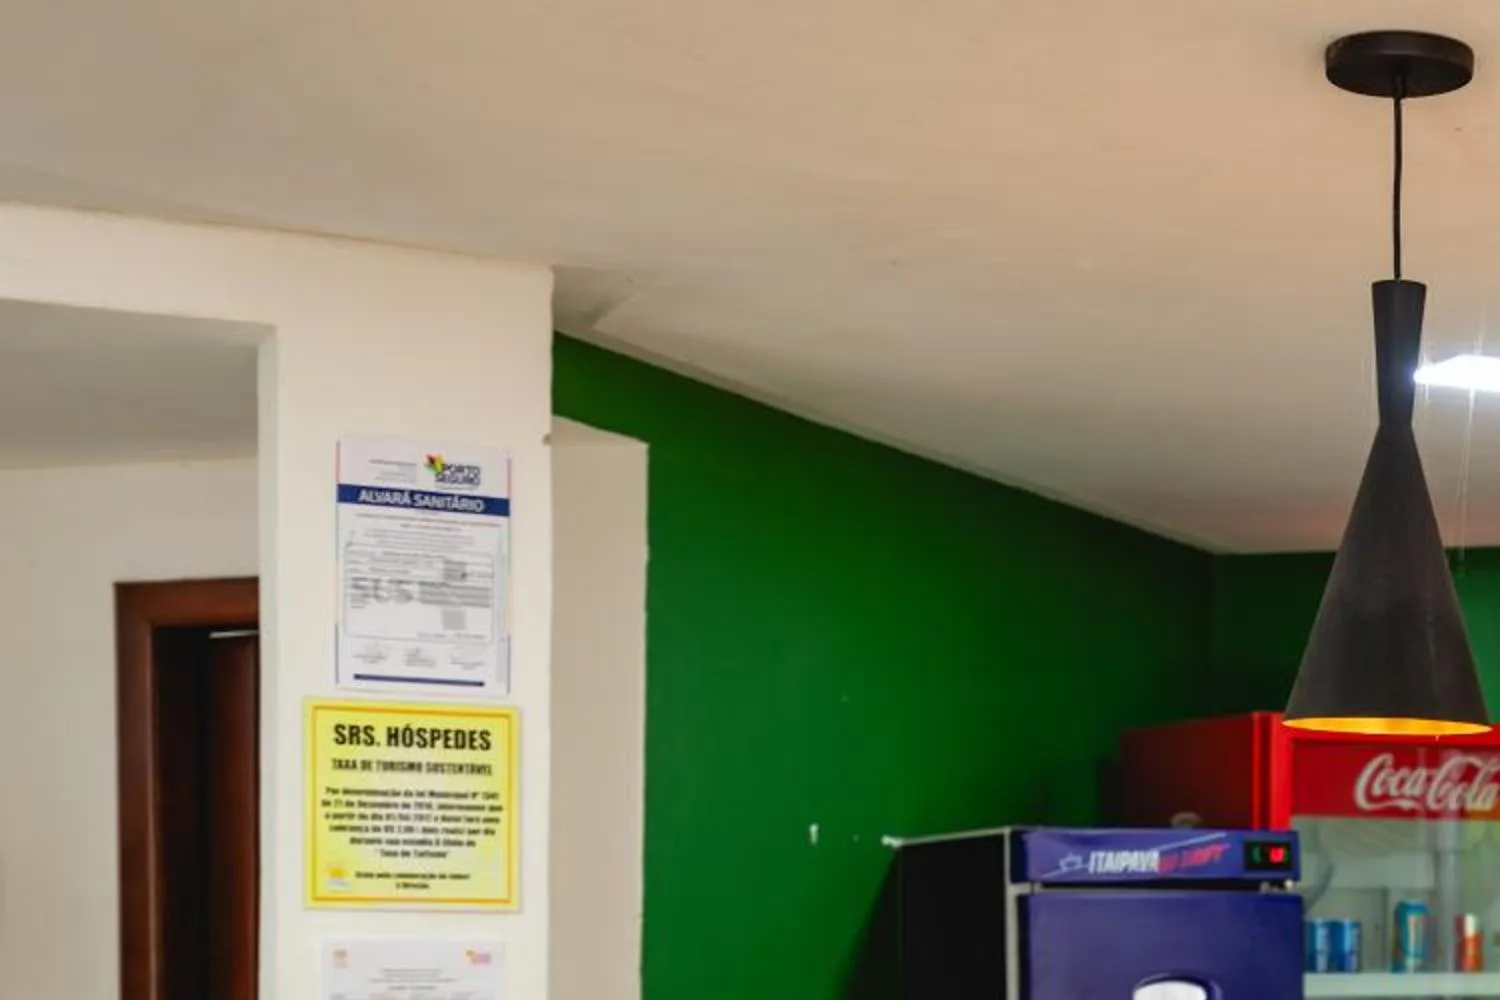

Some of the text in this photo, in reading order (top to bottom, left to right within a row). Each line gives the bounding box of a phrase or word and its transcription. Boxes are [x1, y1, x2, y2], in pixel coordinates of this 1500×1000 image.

[358, 489, 485, 512] ALVARÁ SANITÁRIO
[333, 723, 492, 751] SRS. HÓSPEDES
[332, 757, 357, 771] TAXA
[360, 759, 373, 772] DE
[376, 760, 422, 773] TURISMO
[1088, 849, 1160, 875] ITAIPAVA
